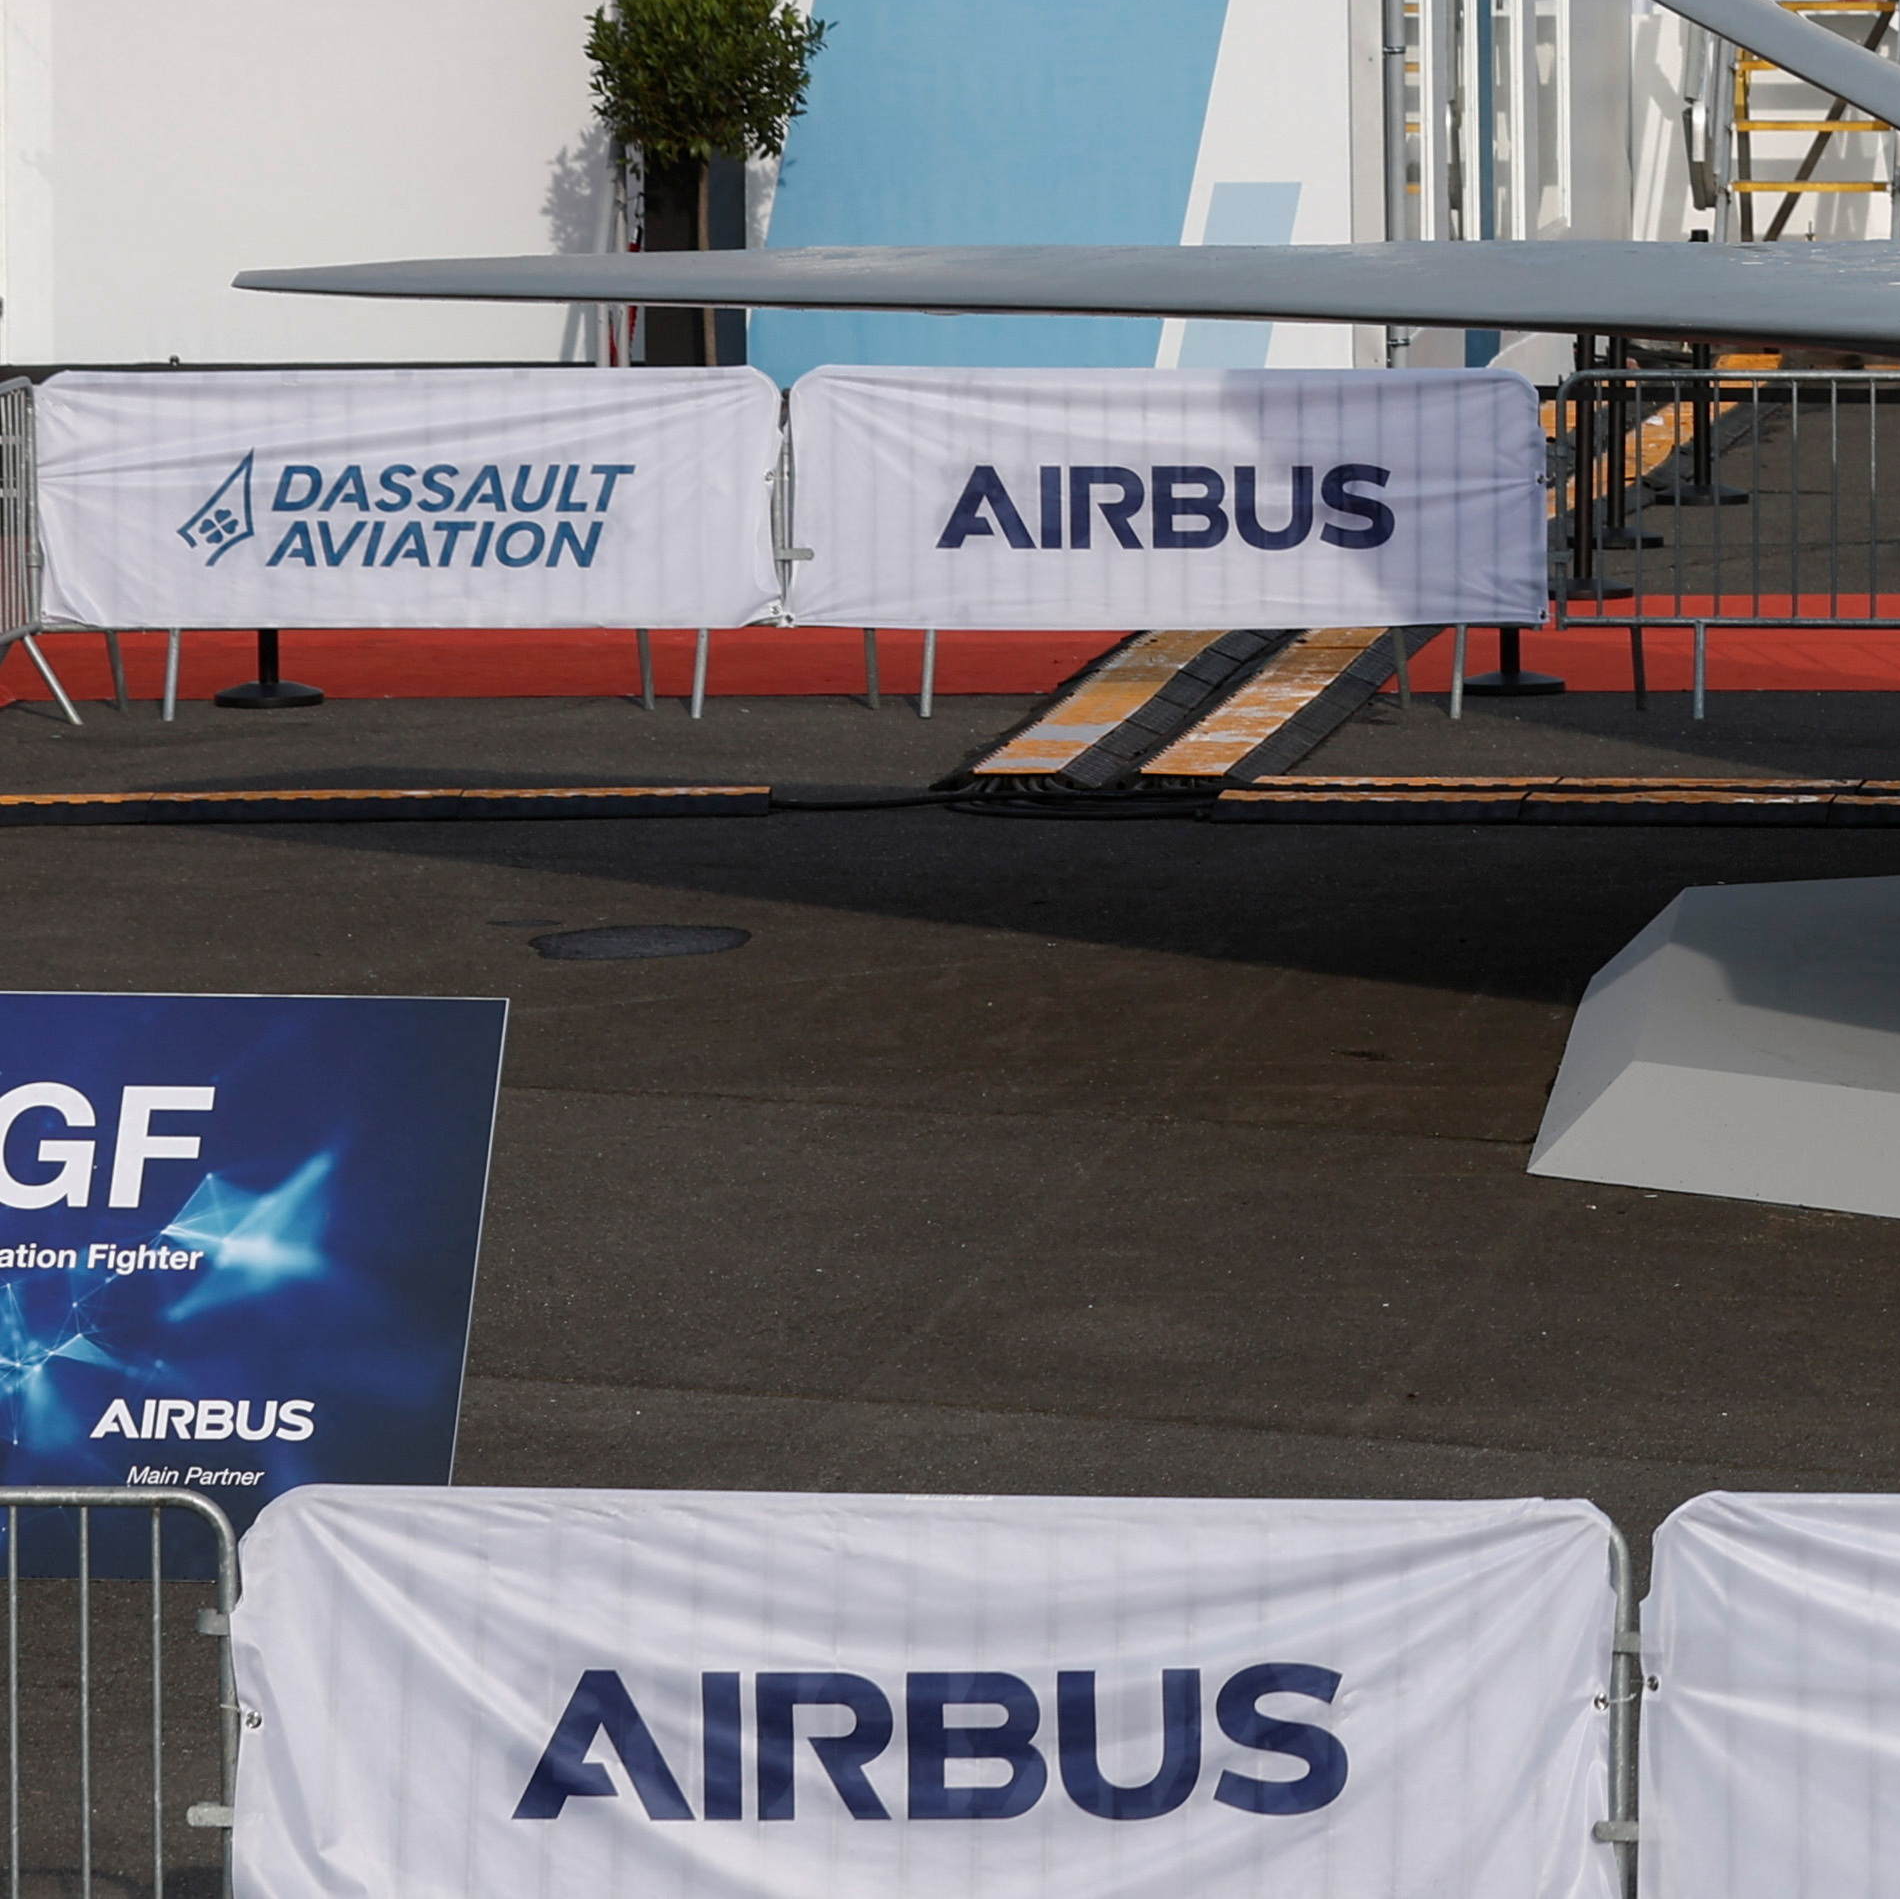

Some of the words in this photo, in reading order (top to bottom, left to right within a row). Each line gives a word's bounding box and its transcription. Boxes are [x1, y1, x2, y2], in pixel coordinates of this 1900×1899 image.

[272, 463, 636, 513] DASSAULT
[935, 463, 1396, 551] AIRBUS
[267, 520, 605, 568] AVIATION
[0, 1081, 216, 1210] GF
[87, 1243, 204, 1275] Fighter
[90, 1397, 315, 1441] AIRBUS
[127, 1464, 180, 1486] Main
[184, 1465, 264, 1486] Partner
[511, 1659, 1351, 1822] AIRBUS
